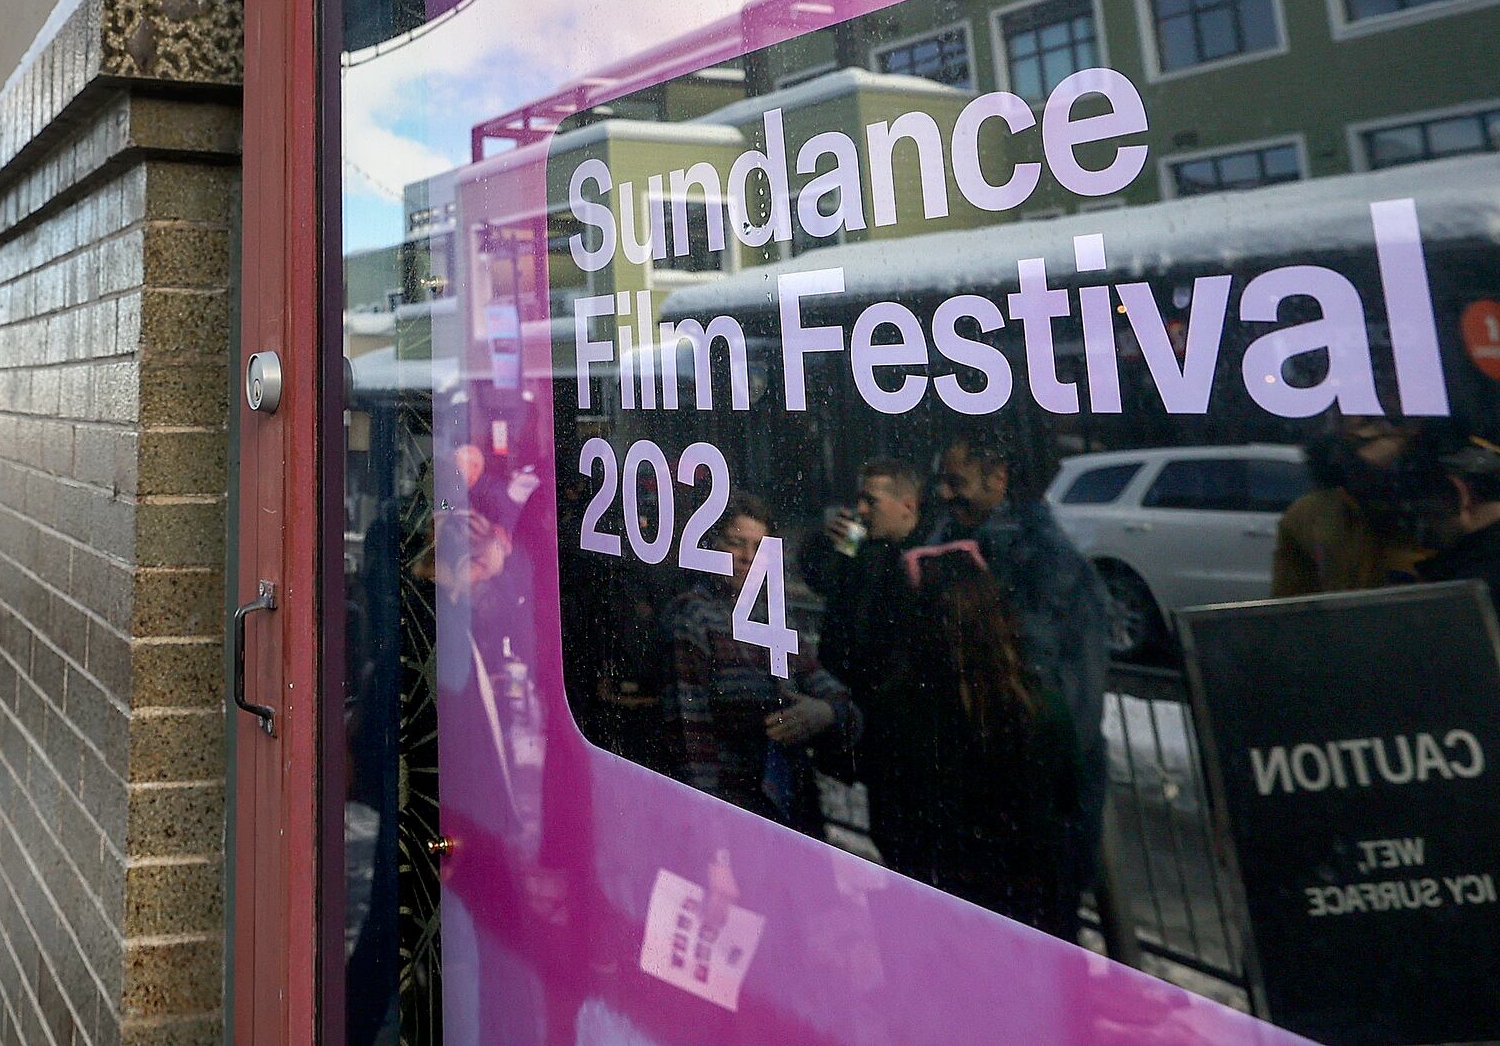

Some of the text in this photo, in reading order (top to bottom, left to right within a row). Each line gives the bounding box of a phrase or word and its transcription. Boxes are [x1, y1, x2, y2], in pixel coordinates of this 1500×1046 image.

[569, 67, 1149, 272] Sundance
[574, 197, 1450, 418] Film Festival
[579, 437, 799, 680] 2024
